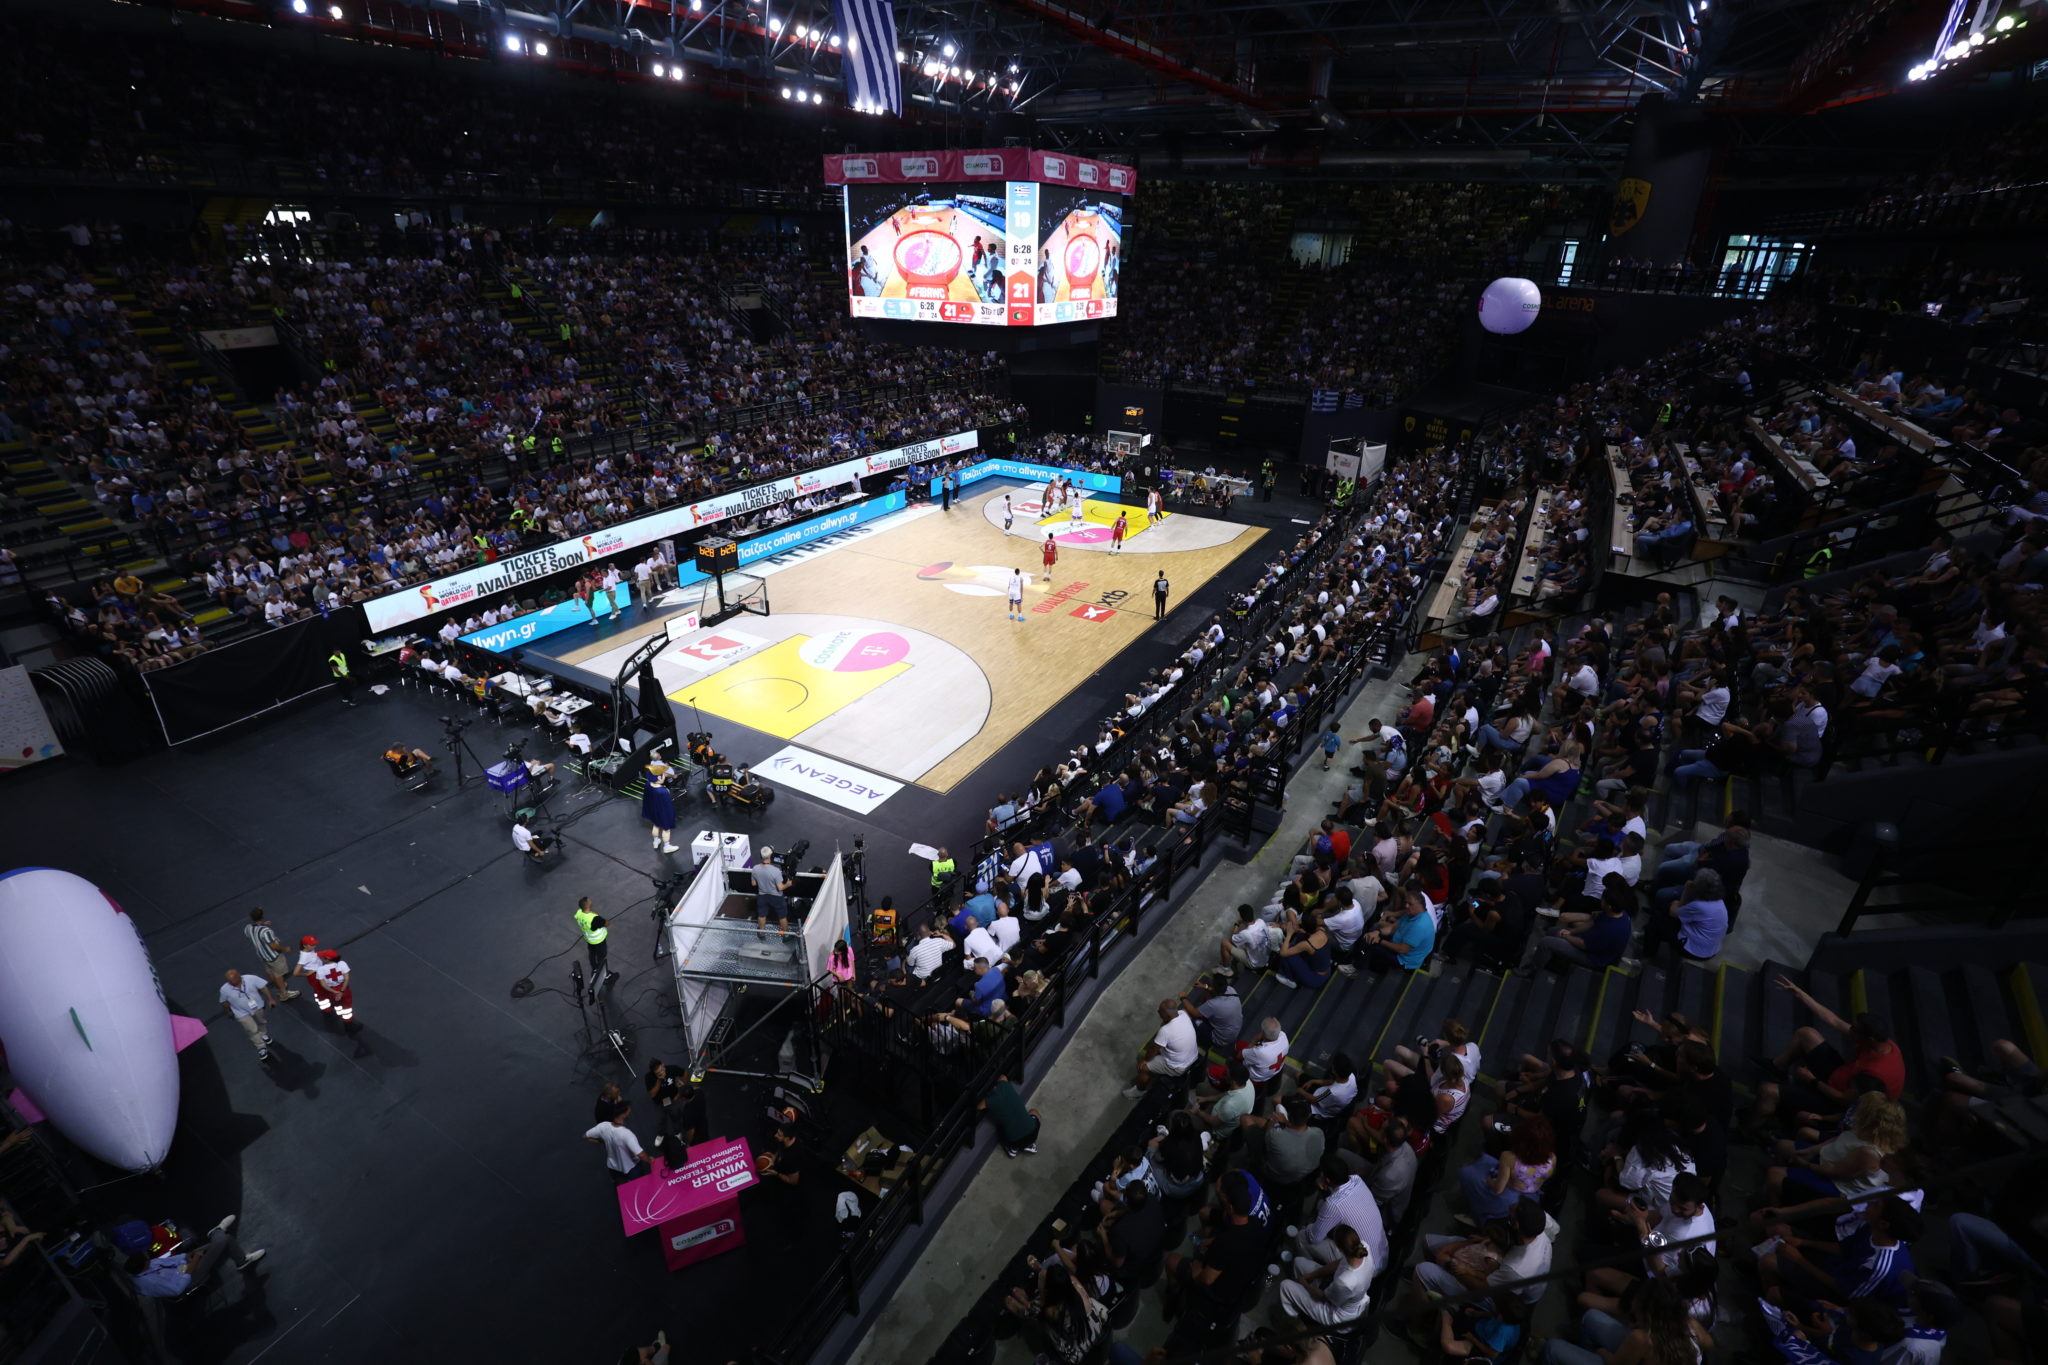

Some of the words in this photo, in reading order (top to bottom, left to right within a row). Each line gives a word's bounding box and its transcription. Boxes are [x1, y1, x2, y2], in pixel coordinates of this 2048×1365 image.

[1013, 245, 1032, 254] 6:28
[1012, 283, 1030, 298] 21
[920, 301, 935, 310] 6:28
[944, 304, 957, 317] 21
[1555, 296, 1595, 311] arena
[889, 453, 923, 469] AVAILABLE
[923, 448, 940, 459] SOON
[901, 443, 928, 456] TICKETS
[982, 463, 1001, 474] online
[1019, 466, 1060, 483] allwyn.gr
[741, 483, 777, 501] TICKETS
[725, 495, 772, 517] AVAILABLE
[772, 488, 794, 503] SOON
[773, 529, 802, 547] online
[803, 523, 820, 537] στο
[820, 511, 858, 532] allwyn.gr
[596, 540, 612, 548] WORLD
[612, 537, 622, 545] CUP
[765, 524, 873, 566] ATHENS
[501, 547, 557, 574] TICKETS
[476, 564, 549, 597] AVAILABLE
[550, 551, 584, 572] SOON
[439, 587, 460, 599] WORLD
[460, 584, 472, 594] CUP
[440, 594, 460, 607] QATAR
[459, 590, 474, 602] 2027
[1031, 581, 1091, 614] QUALIFIERS
[1096, 589, 1129, 607] xtb
[813, 631, 852, 664] COSMOTE
[791, 763, 884, 800] AEGEAN
[1041, 852, 1053, 866] 77
[713, 1144, 742, 1159] Halftime
[674, 1156, 712, 1174] Challenge
[706, 1151, 745, 1171] COSMOTE
[668, 1168, 704, 1187] TELEKOM
[692, 1159, 748, 1189] WINNER
[675, 1230, 713, 1247] COSMOTE
